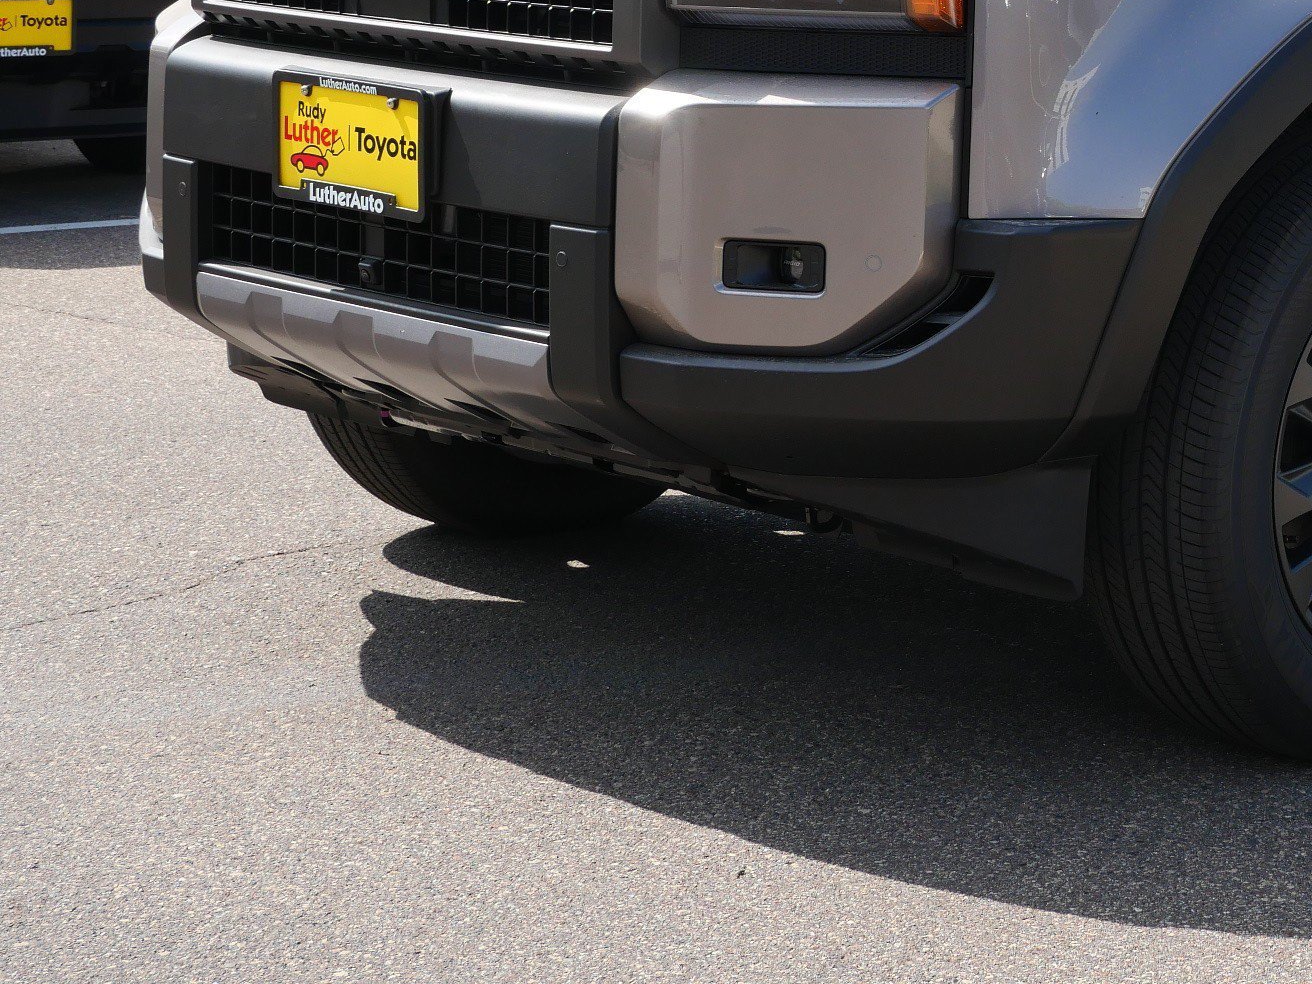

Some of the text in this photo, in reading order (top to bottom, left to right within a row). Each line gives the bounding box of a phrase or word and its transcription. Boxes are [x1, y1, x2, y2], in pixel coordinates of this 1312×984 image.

[20, 14, 68, 30] Toyota
[319, 76, 377, 96] LutherAuto.com
[297, 100, 327, 124] Rudy
[284, 115, 338, 147] Luther
[354, 126, 417, 162] Toyota
[308, 182, 384, 214] LutherAuto
